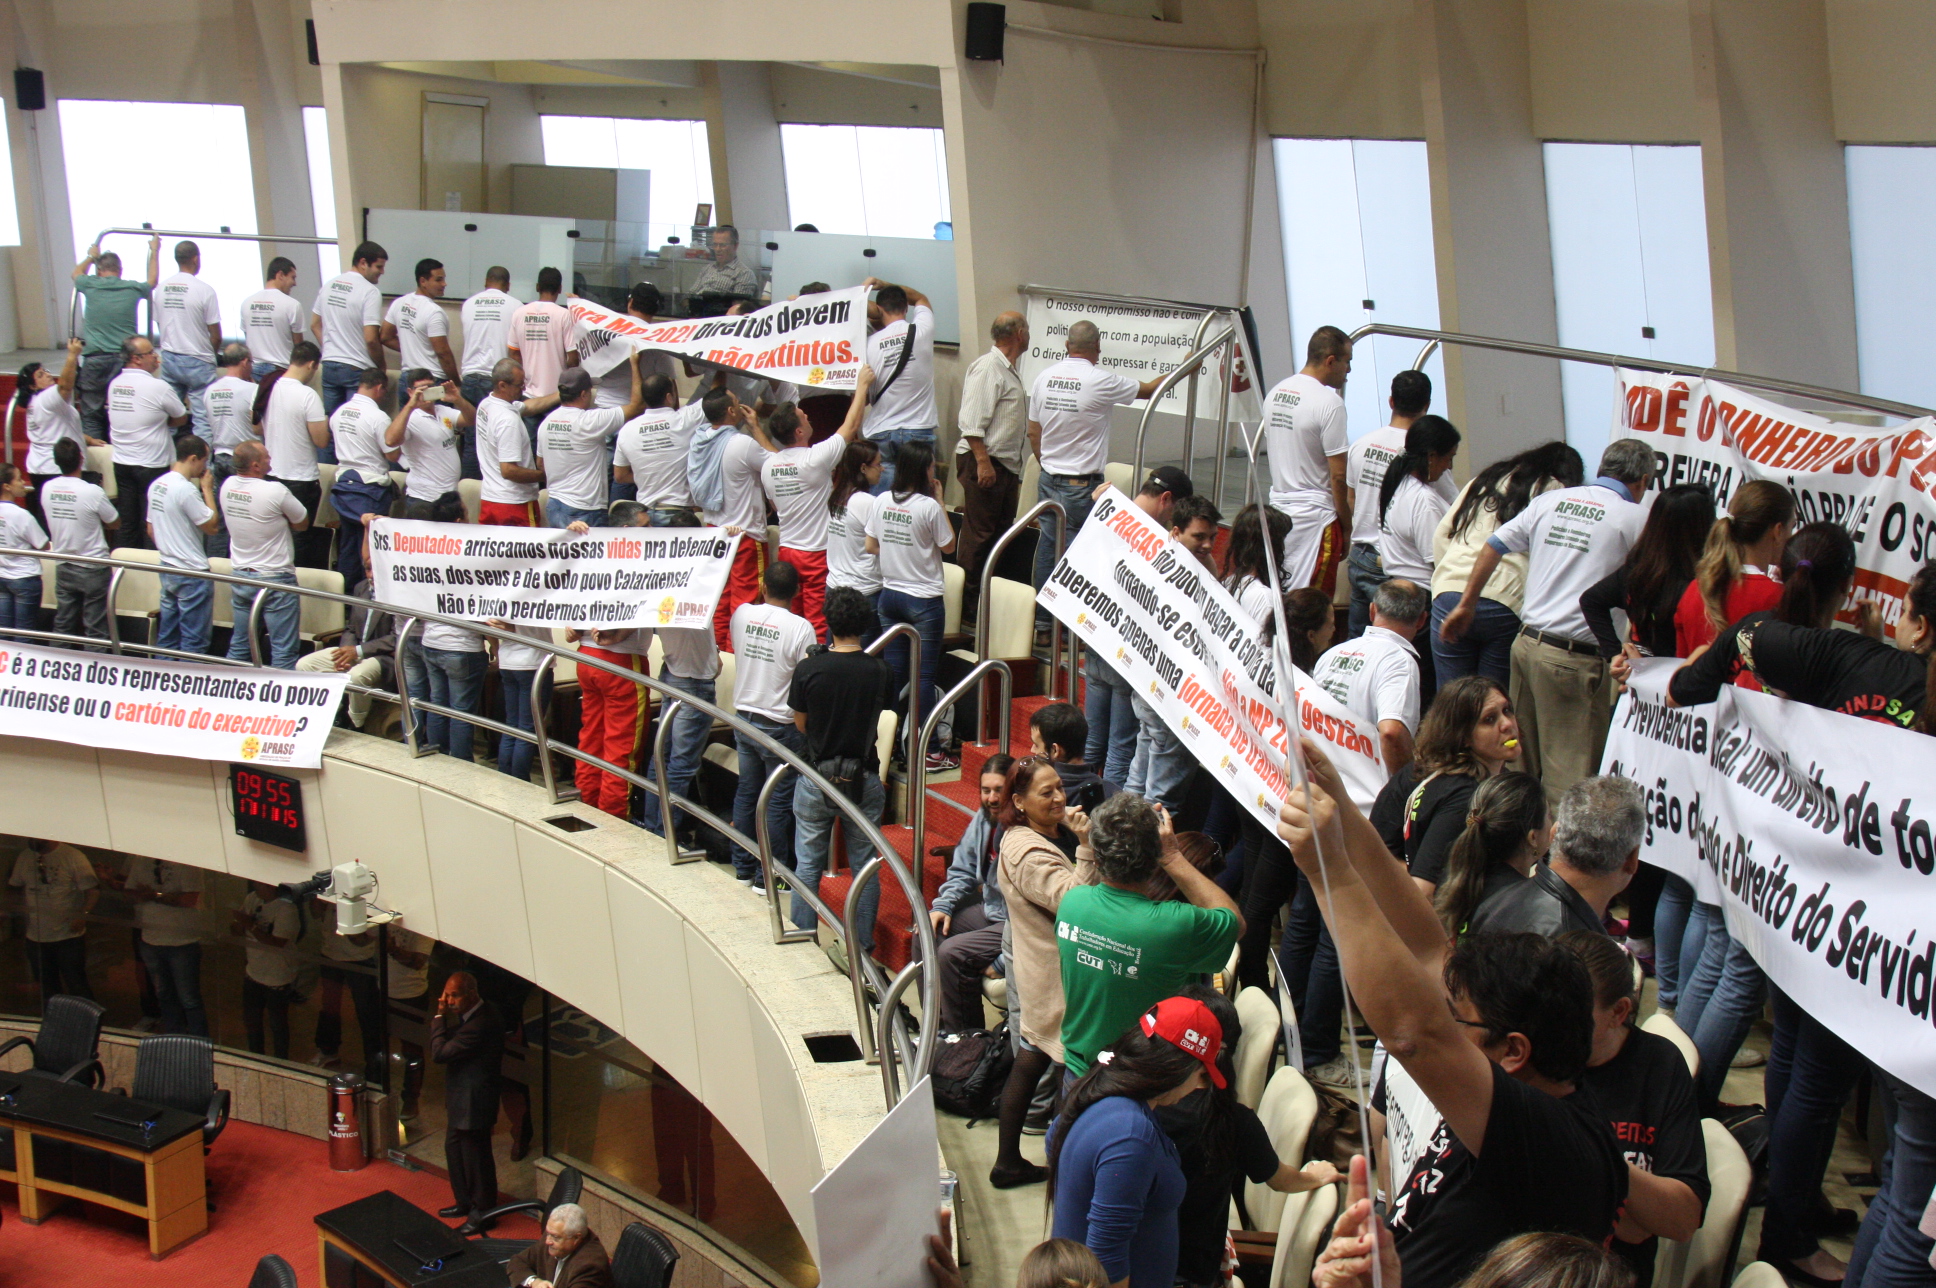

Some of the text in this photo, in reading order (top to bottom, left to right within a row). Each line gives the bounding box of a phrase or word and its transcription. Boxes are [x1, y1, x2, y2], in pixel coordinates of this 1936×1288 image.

[641, 324, 698, 343] 202!
[691, 315, 773, 341] Direitos
[777, 299, 851, 333] devem
[1046, 298, 1054, 309] O
[1056, 301, 1084, 312] nosso
[1087, 304, 1150, 317] compromisso
[1046, 323, 1069, 337] políti
[1111, 331, 1130, 342] com
[1133, 333, 1139, 342] a
[1141, 333, 1194, 348] população
[706, 340, 859, 371] não extintos.
[1032, 347, 1040, 358] O
[1043, 348, 1069, 361] direit
[1102, 356, 1149, 370] expressar
[1151, 359, 1157, 371] é
[826, 368, 857, 380] APRASC
[1047, 380, 1081, 391] APRASC
[1697, 394, 1717, 442] O
[1364, 448, 1395, 465] APRAS
[1554, 501, 1605, 521] APRASC
[1880, 501, 1906, 551] O
[373, 530, 392, 551] Srs.
[394, 531, 462, 558] Deputados
[464, 535, 546, 559] arriscamos
[548, 540, 604, 559] nossas
[607, 536, 642, 559] vidas
[644, 540, 666, 561] pra
[392, 562, 693, 592] as suas, dos seus e de todo povo Catarinense!
[437, 593, 465, 615] Não
[468, 593, 476, 615] é
[477, 595, 507, 617] justo
[511, 597, 587, 622] perdermos
[745, 624, 780, 640] APRASC
[1094, 498, 1116, 522] Os
[1106, 509, 1165, 562] PRAÇAS
[1202, 595, 1237, 643] pagar
[1228, 629, 1244, 653] a
[1302, 698, 1380, 766] gestão.
[1051, 557, 1123, 629] Queremos
[1118, 614, 1156, 666] apenas
[1156, 650, 1183, 691] uma
[1177, 673, 1235, 740] jornada
[11, 653, 22, 675] é
[26, 661, 36, 676] a
[40, 661, 81, 682] casa
[86, 661, 118, 686] dos
[121, 667, 256, 701] representantes
[259, 680, 282, 704] do
[286, 686, 330, 708] povo
[73, 697, 95, 717] ou
[100, 700, 111, 720] o
[115, 700, 184, 728] cartório
[188, 705, 212, 731] do
[212, 709, 309, 738] executivo?
[1250, 697, 1274, 737] MP
[261, 742, 296, 755] APRASC
[1737, 748, 1780, 797] um
[1843, 780, 1884, 856] de
[1891, 798, 1936, 875] to
[1722, 841, 1731, 887] e
[1730, 832, 1798, 930] Direito
[1791, 883, 1833, 953] do
[1825, 899, 1936, 1030] Servid
[1078, 953, 1101, 967] CUT
